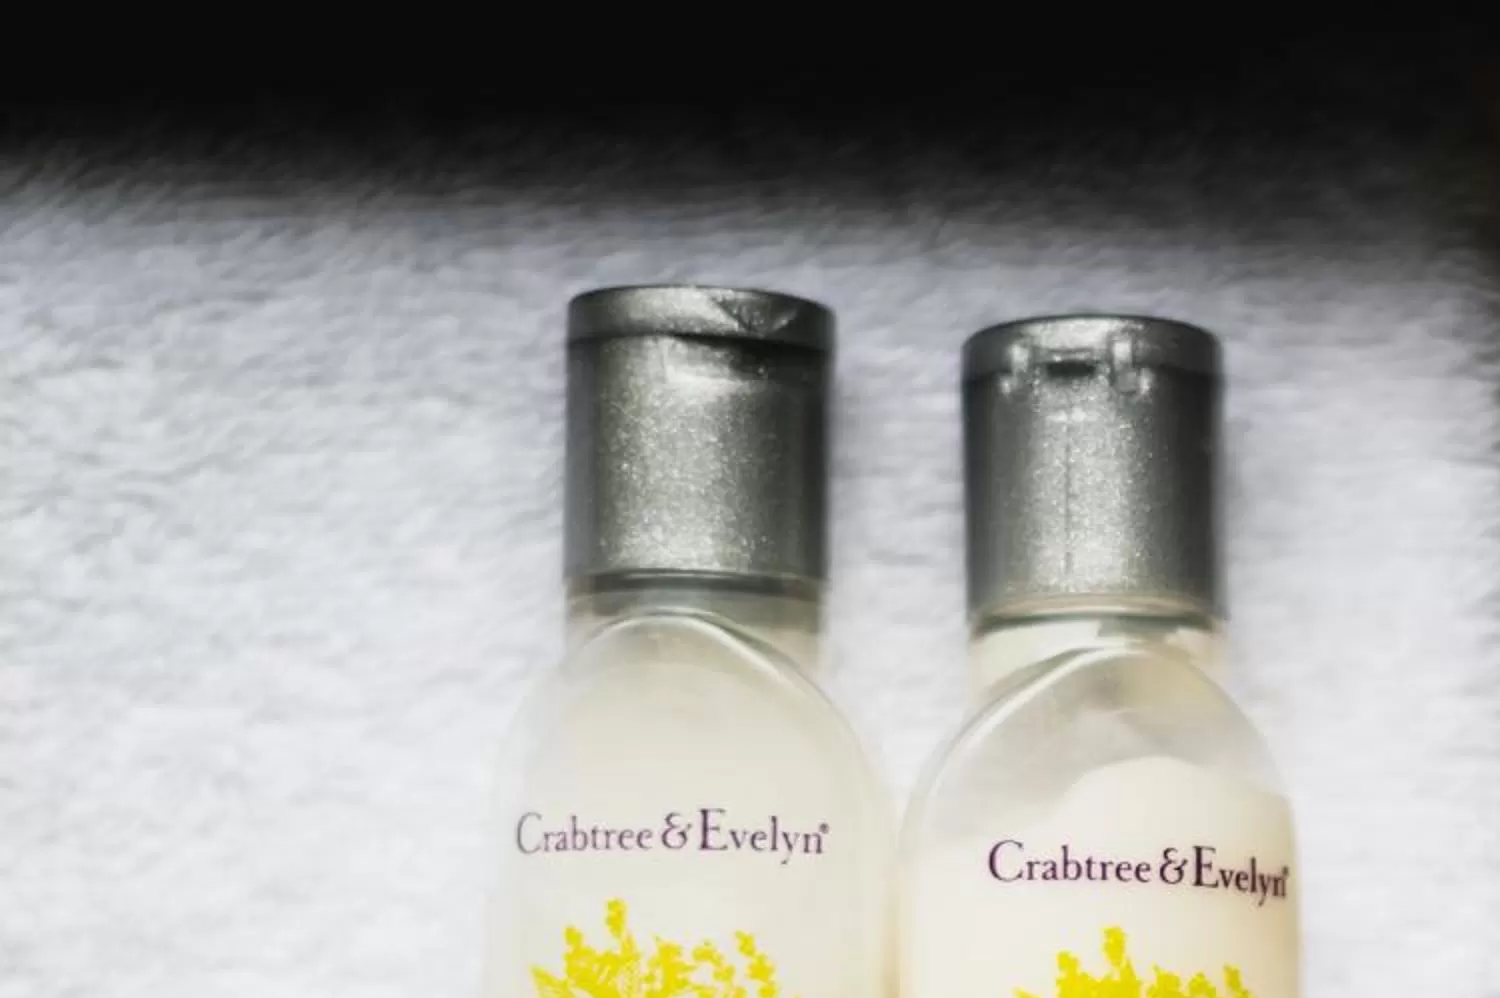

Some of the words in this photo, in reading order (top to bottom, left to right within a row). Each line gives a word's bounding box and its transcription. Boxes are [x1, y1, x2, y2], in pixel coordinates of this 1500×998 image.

[516, 812, 652, 855] Crabtree
[662, 813, 692, 850] &
[988, 839, 1151, 883] Crabtree
[1159, 848, 1188, 885] &
